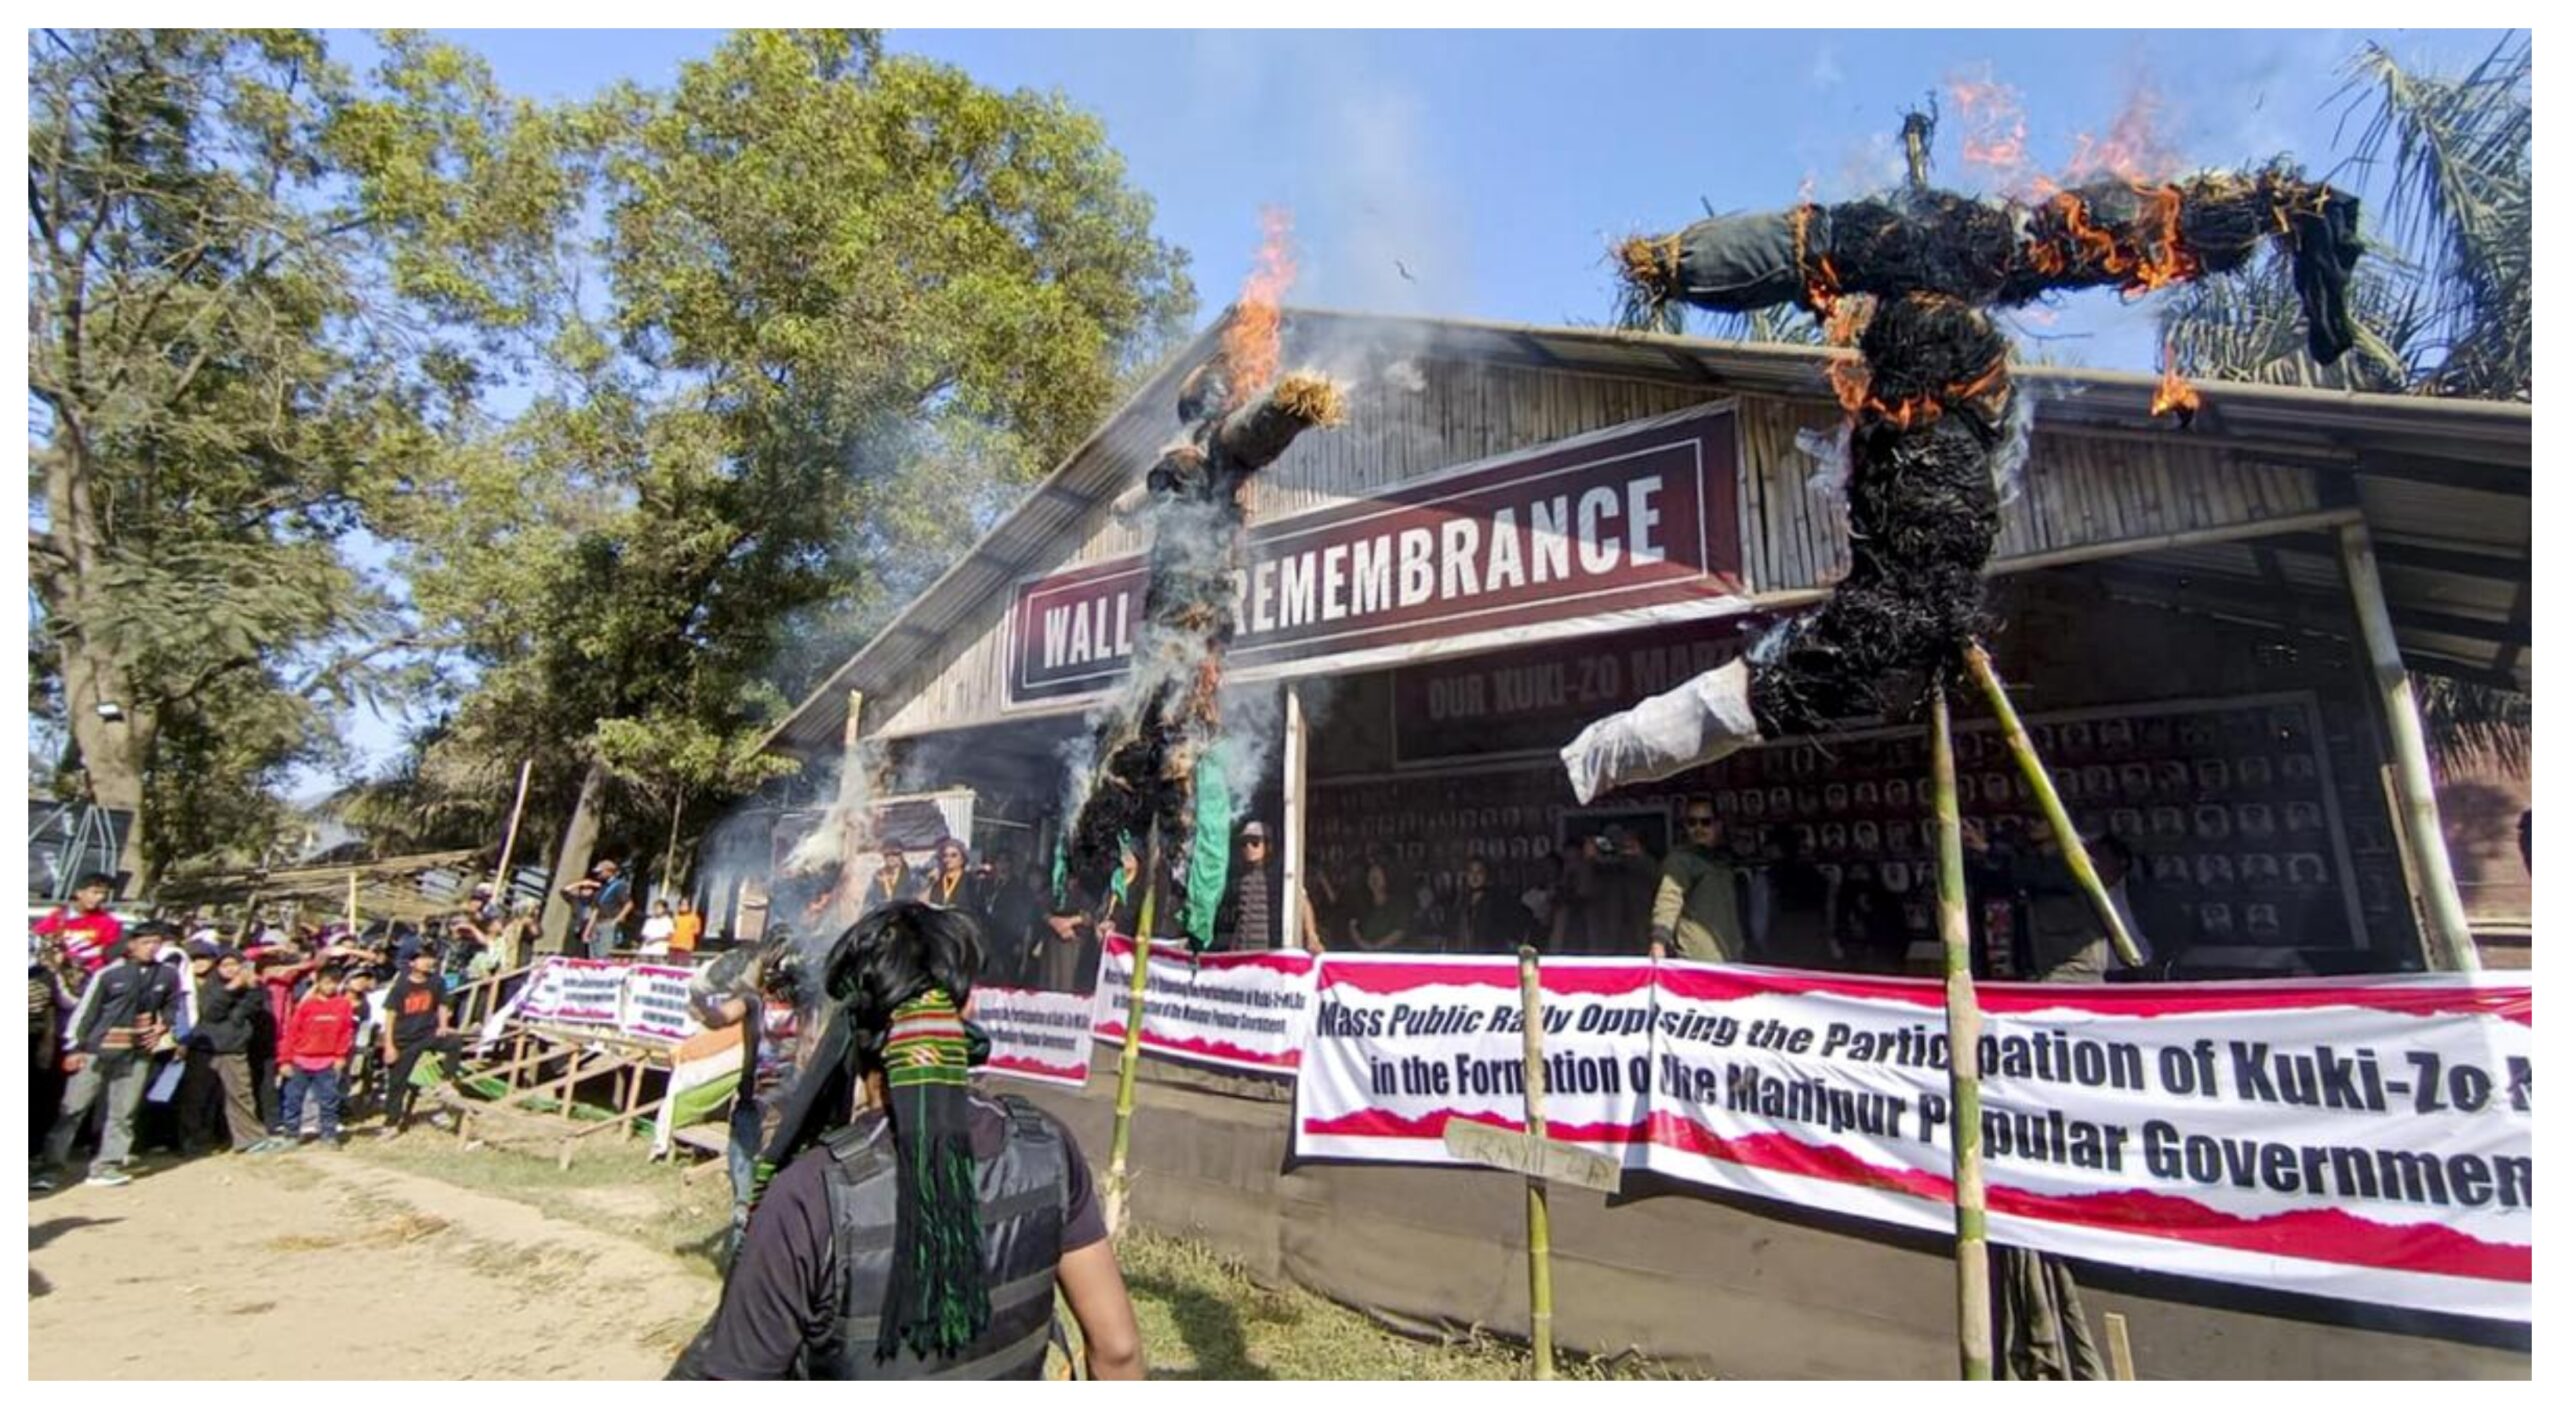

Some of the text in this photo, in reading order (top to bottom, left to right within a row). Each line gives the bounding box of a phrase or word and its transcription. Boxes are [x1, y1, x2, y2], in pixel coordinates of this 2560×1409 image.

[1044, 591, 1133, 668] WALL
[1429, 676, 1486, 720] OUR
[1493, 653, 1620, 714] KUKI-ZO
[1317, 1000, 1383, 1037] Mass
[1388, 1003, 1483, 1036] Public
[1487, 1003, 1573, 1033] Raly
[1746, 1019, 1814, 1054] the
[1820, 1022, 2145, 1091] Particpation
[2159, 1038, 2215, 1098] of
[2229, 1041, 2493, 1115] Kuki-Zo
[1371, 1056, 1396, 1095] in
[1402, 1056, 1449, 1096] the
[1628, 1055, 1652, 1094] o
[1726, 1062, 1907, 1138] Manipur
[1918, 1092, 2127, 1172] Ppular
[2142, 1119, 2532, 1208] Governmen
